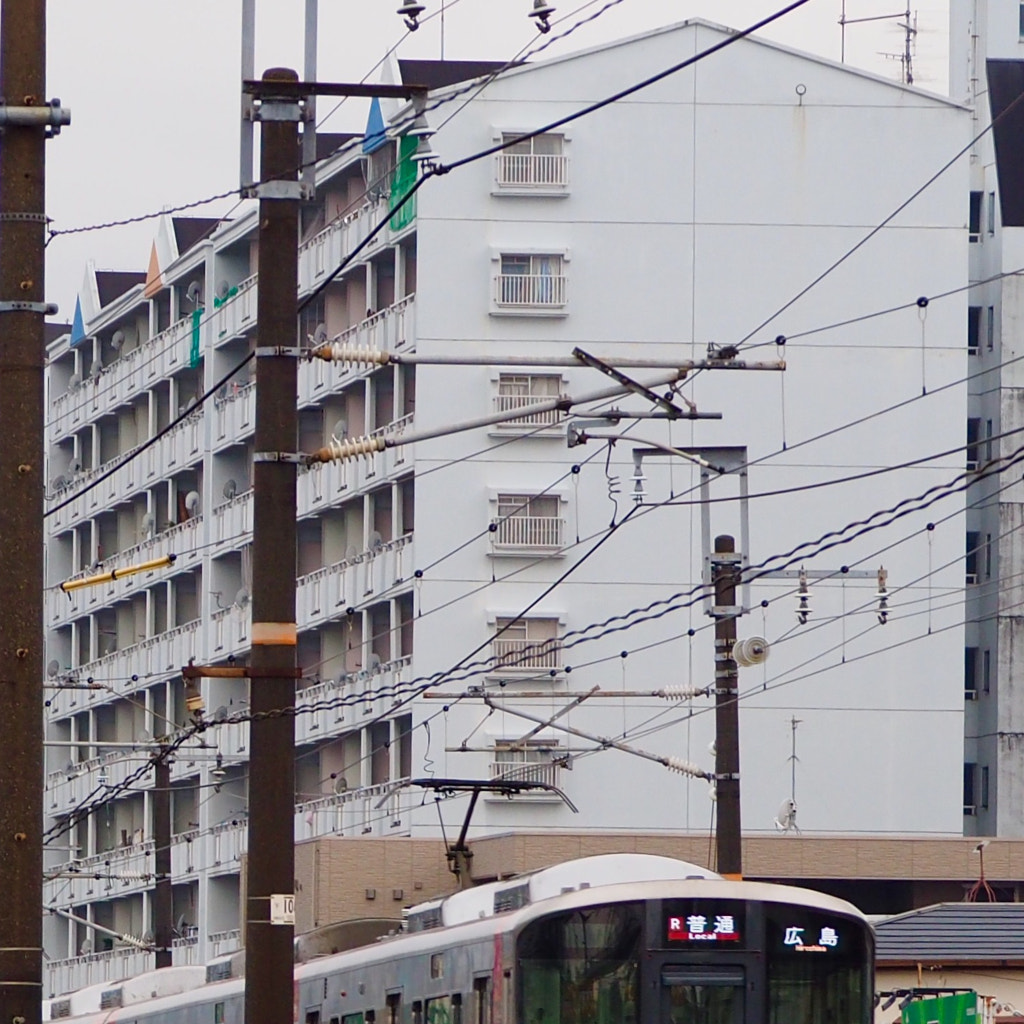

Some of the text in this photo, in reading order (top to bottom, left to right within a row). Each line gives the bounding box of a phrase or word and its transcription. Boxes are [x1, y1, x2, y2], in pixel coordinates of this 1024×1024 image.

[670, 915, 735, 934] R 普通
[783, 926, 839, 946] 広島
